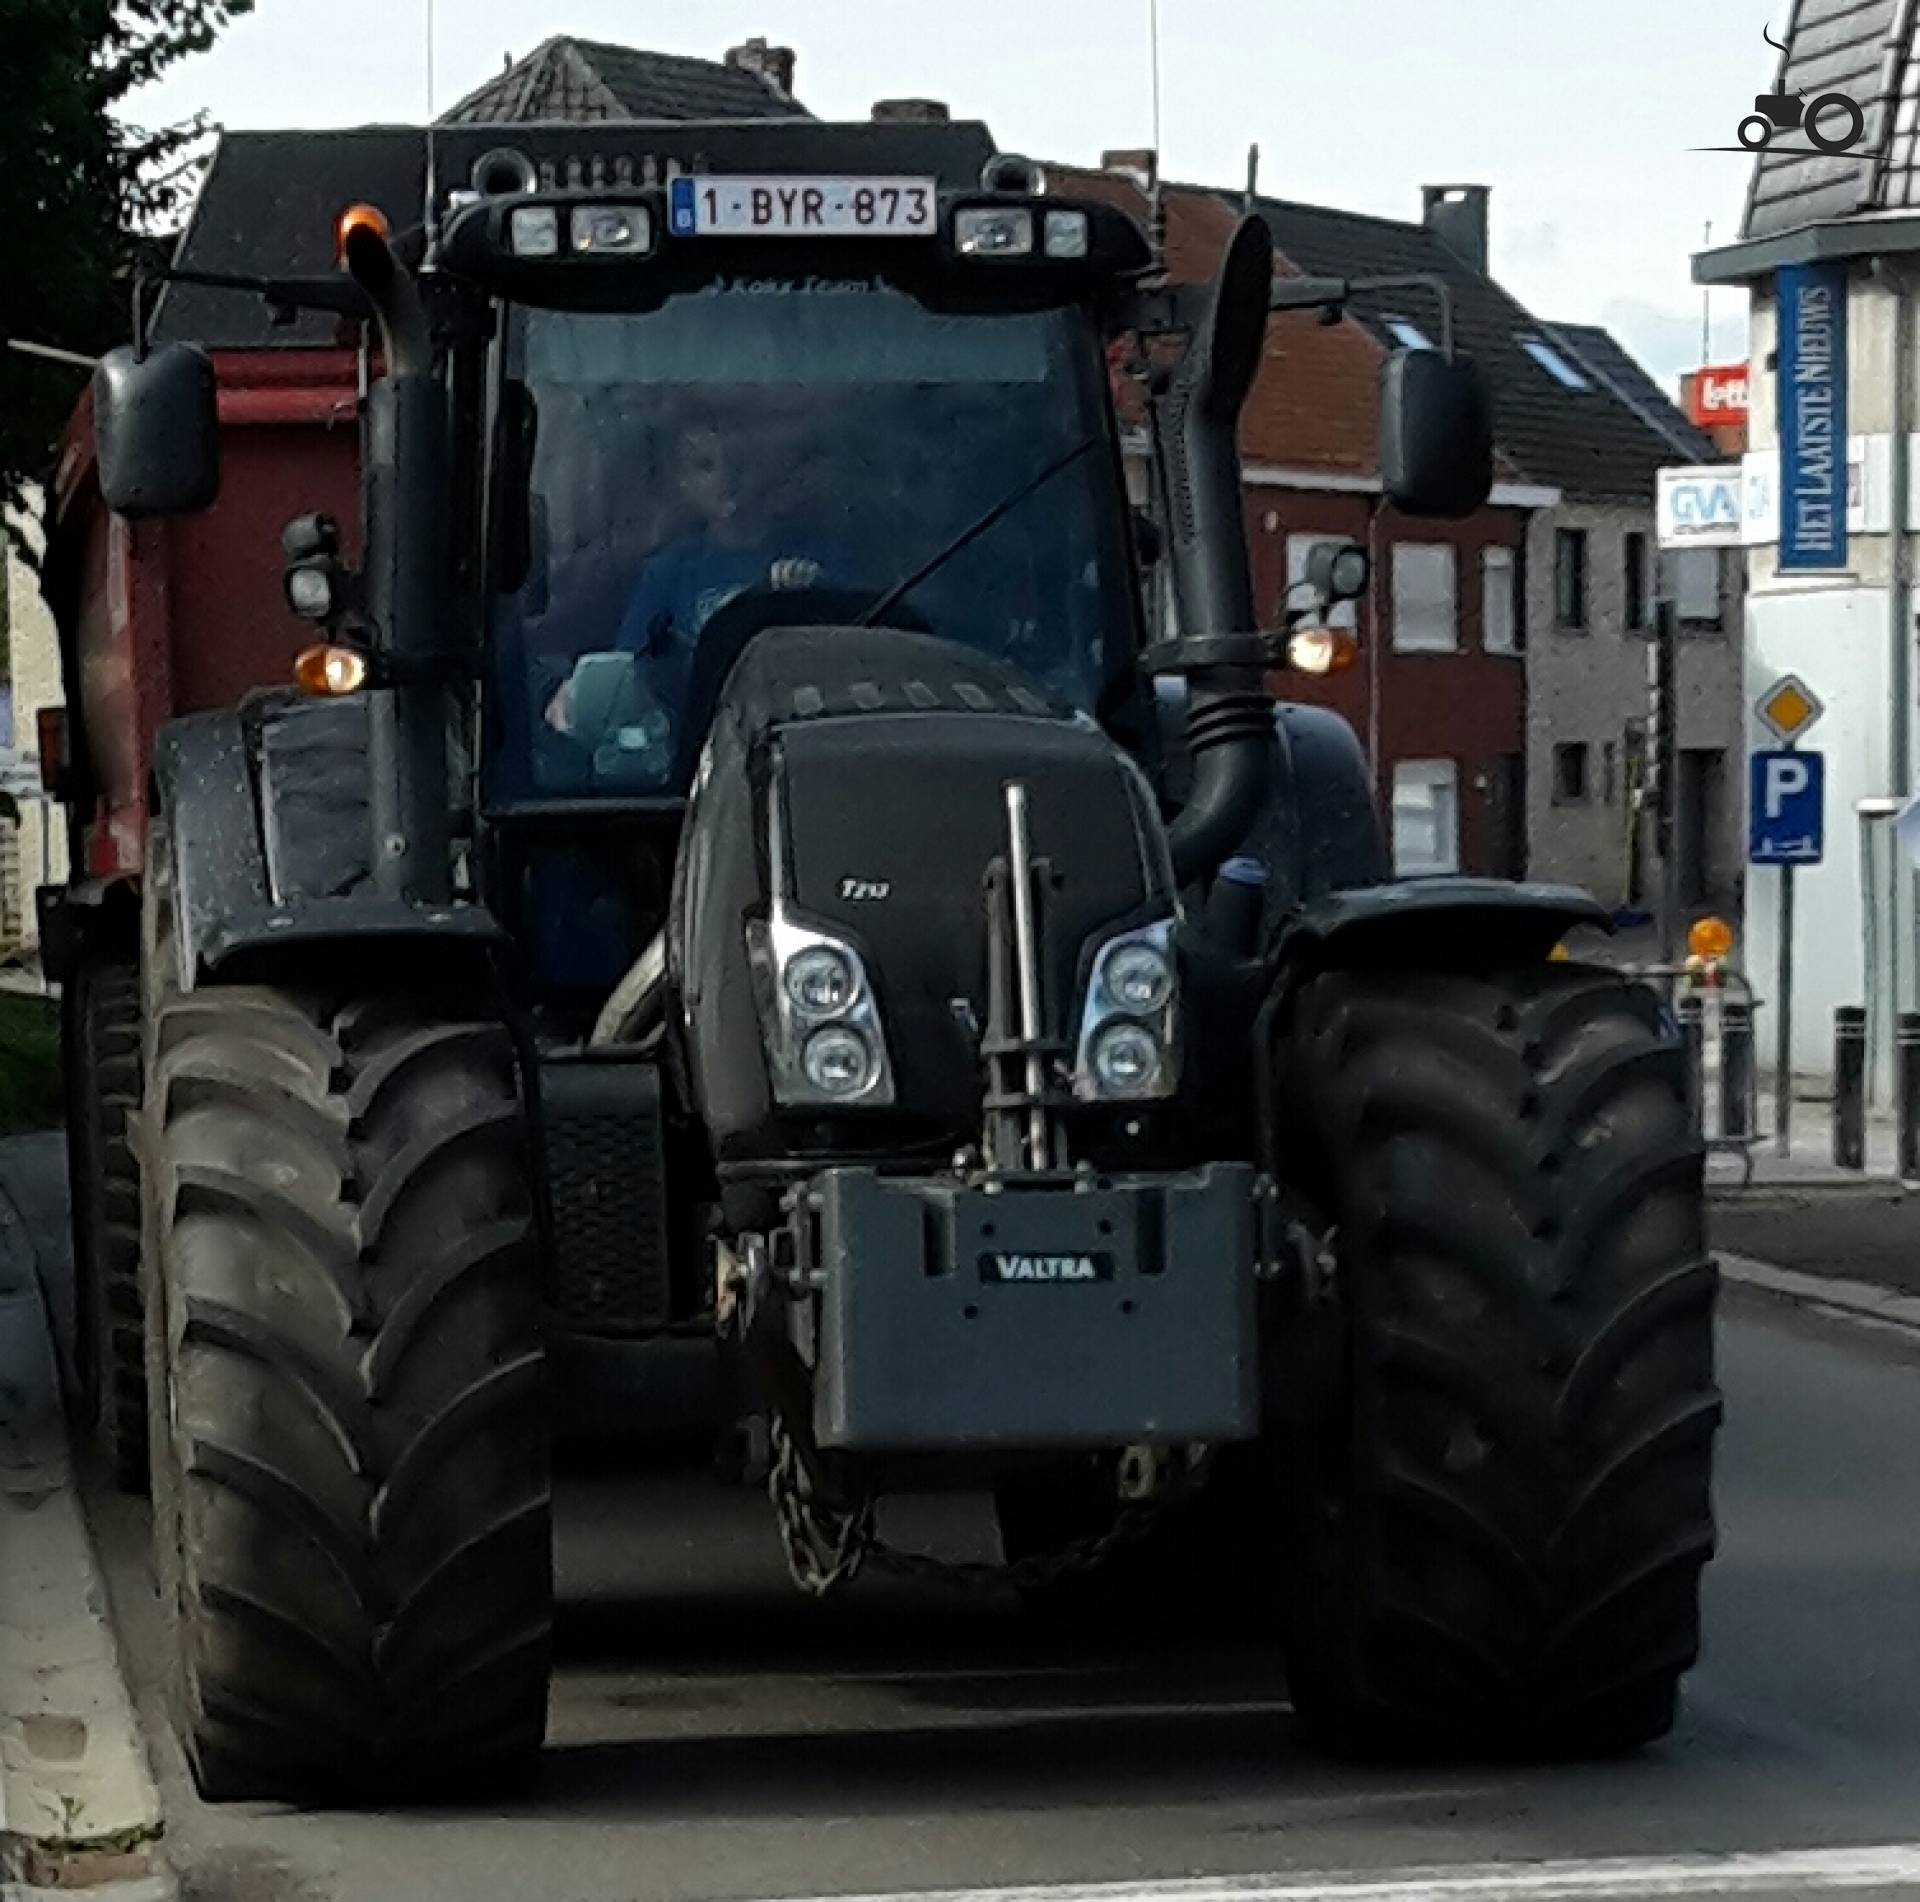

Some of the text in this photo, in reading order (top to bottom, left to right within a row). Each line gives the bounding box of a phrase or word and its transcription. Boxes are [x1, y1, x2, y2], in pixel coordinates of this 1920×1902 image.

[702, 187, 928, 225] 1-BYR-873
[1793, 287, 1832, 551] HET LAATSTE NIEUWS
[1764, 757, 1809, 819] P
[995, 1255, 1096, 1279] VALTRA
